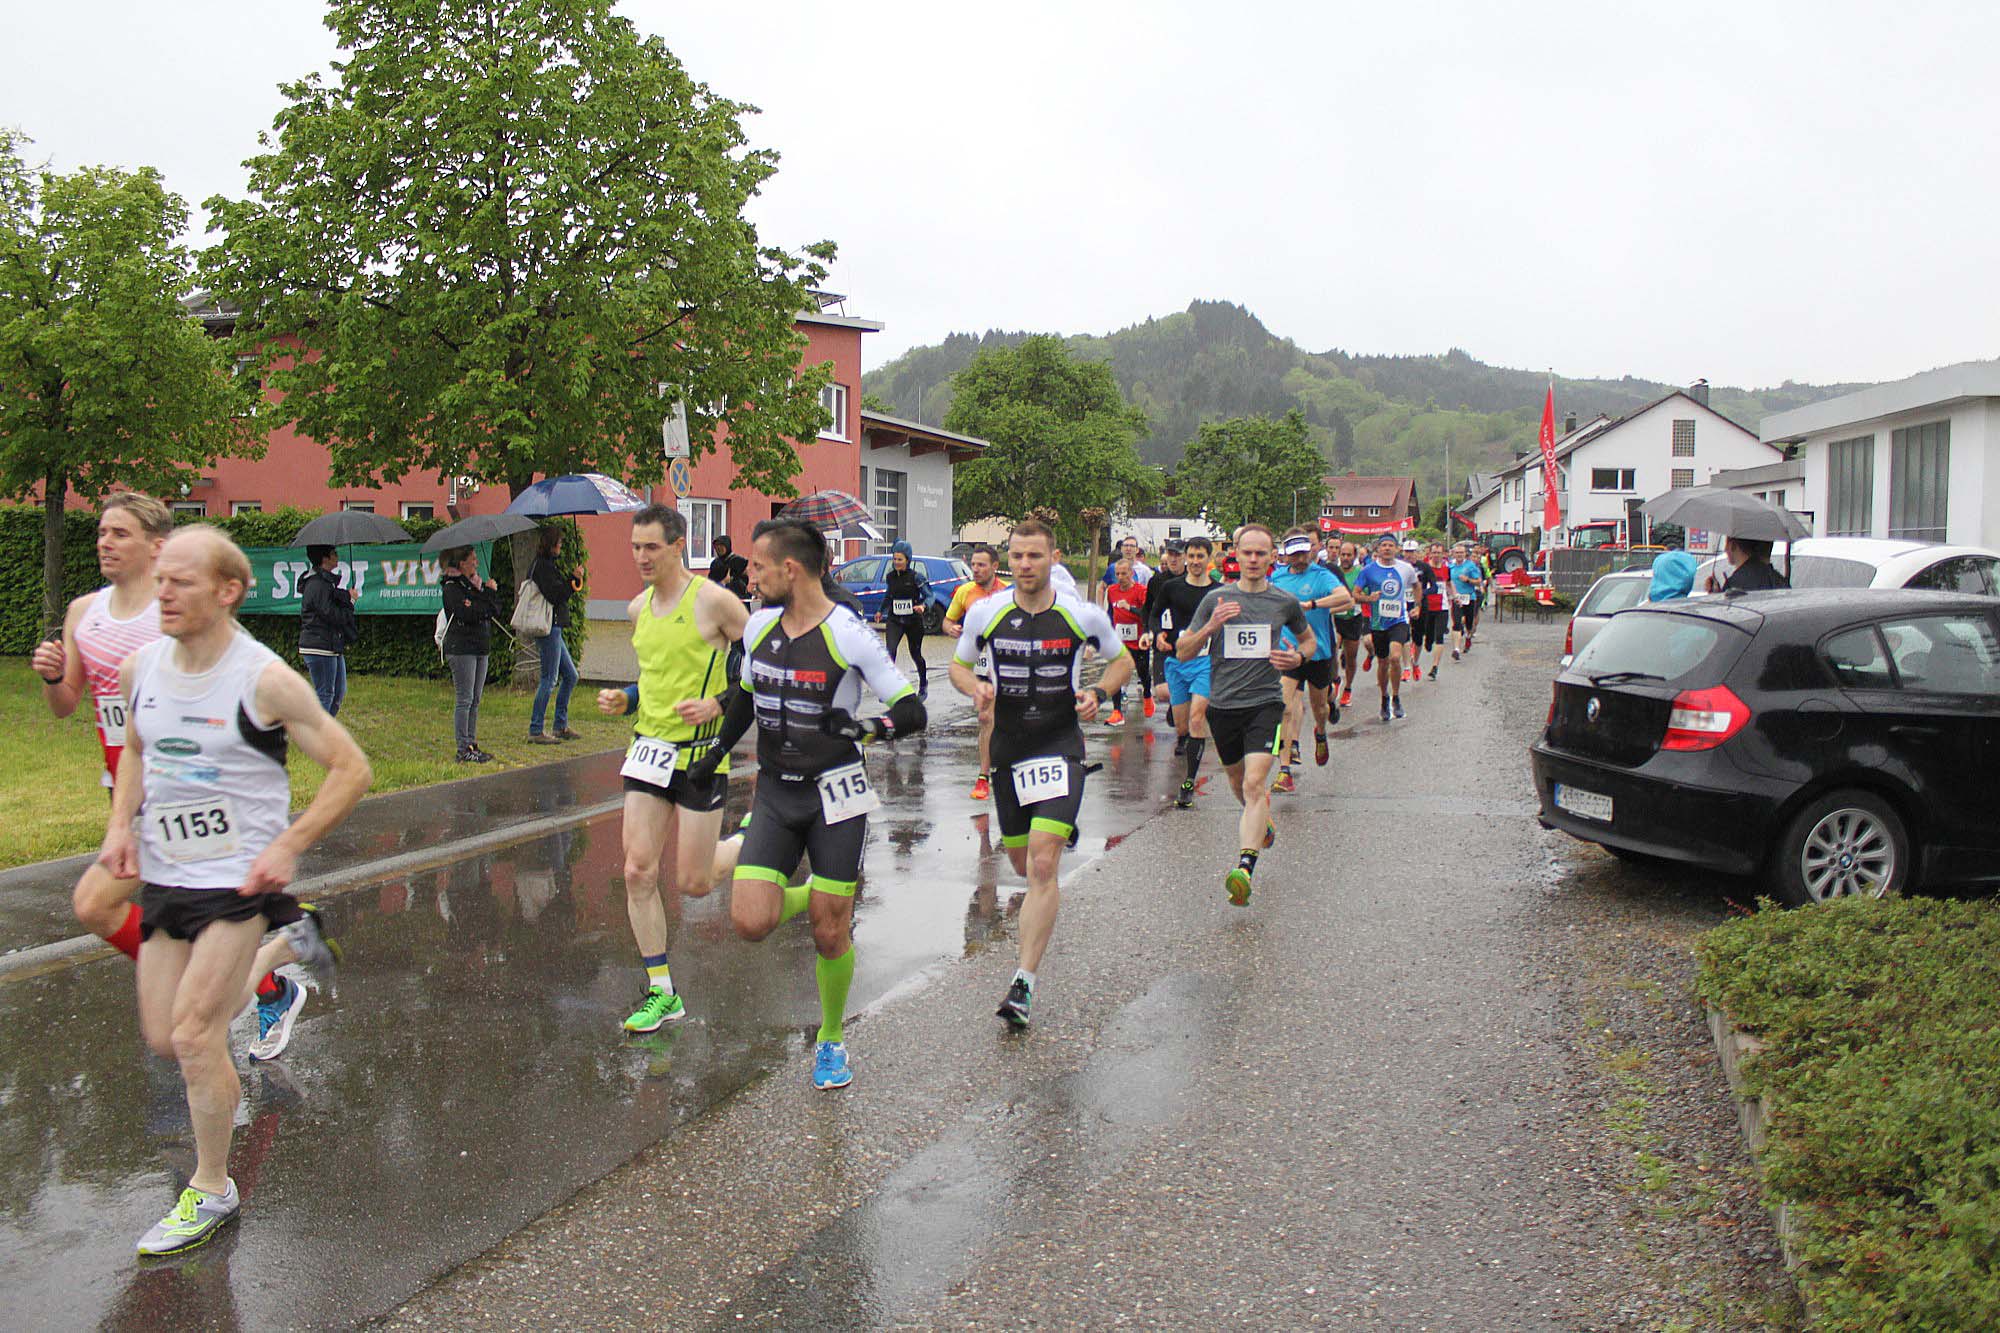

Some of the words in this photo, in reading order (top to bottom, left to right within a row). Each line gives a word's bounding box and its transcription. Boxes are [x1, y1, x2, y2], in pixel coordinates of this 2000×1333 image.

[1121, 627, 1131, 636] 16
[1238, 631, 1257, 646] 65
[103, 704, 128, 728] 10
[632, 744, 673, 770] 1012
[1018, 764, 1063, 789] 1155
[159, 808, 230, 841] 1153
